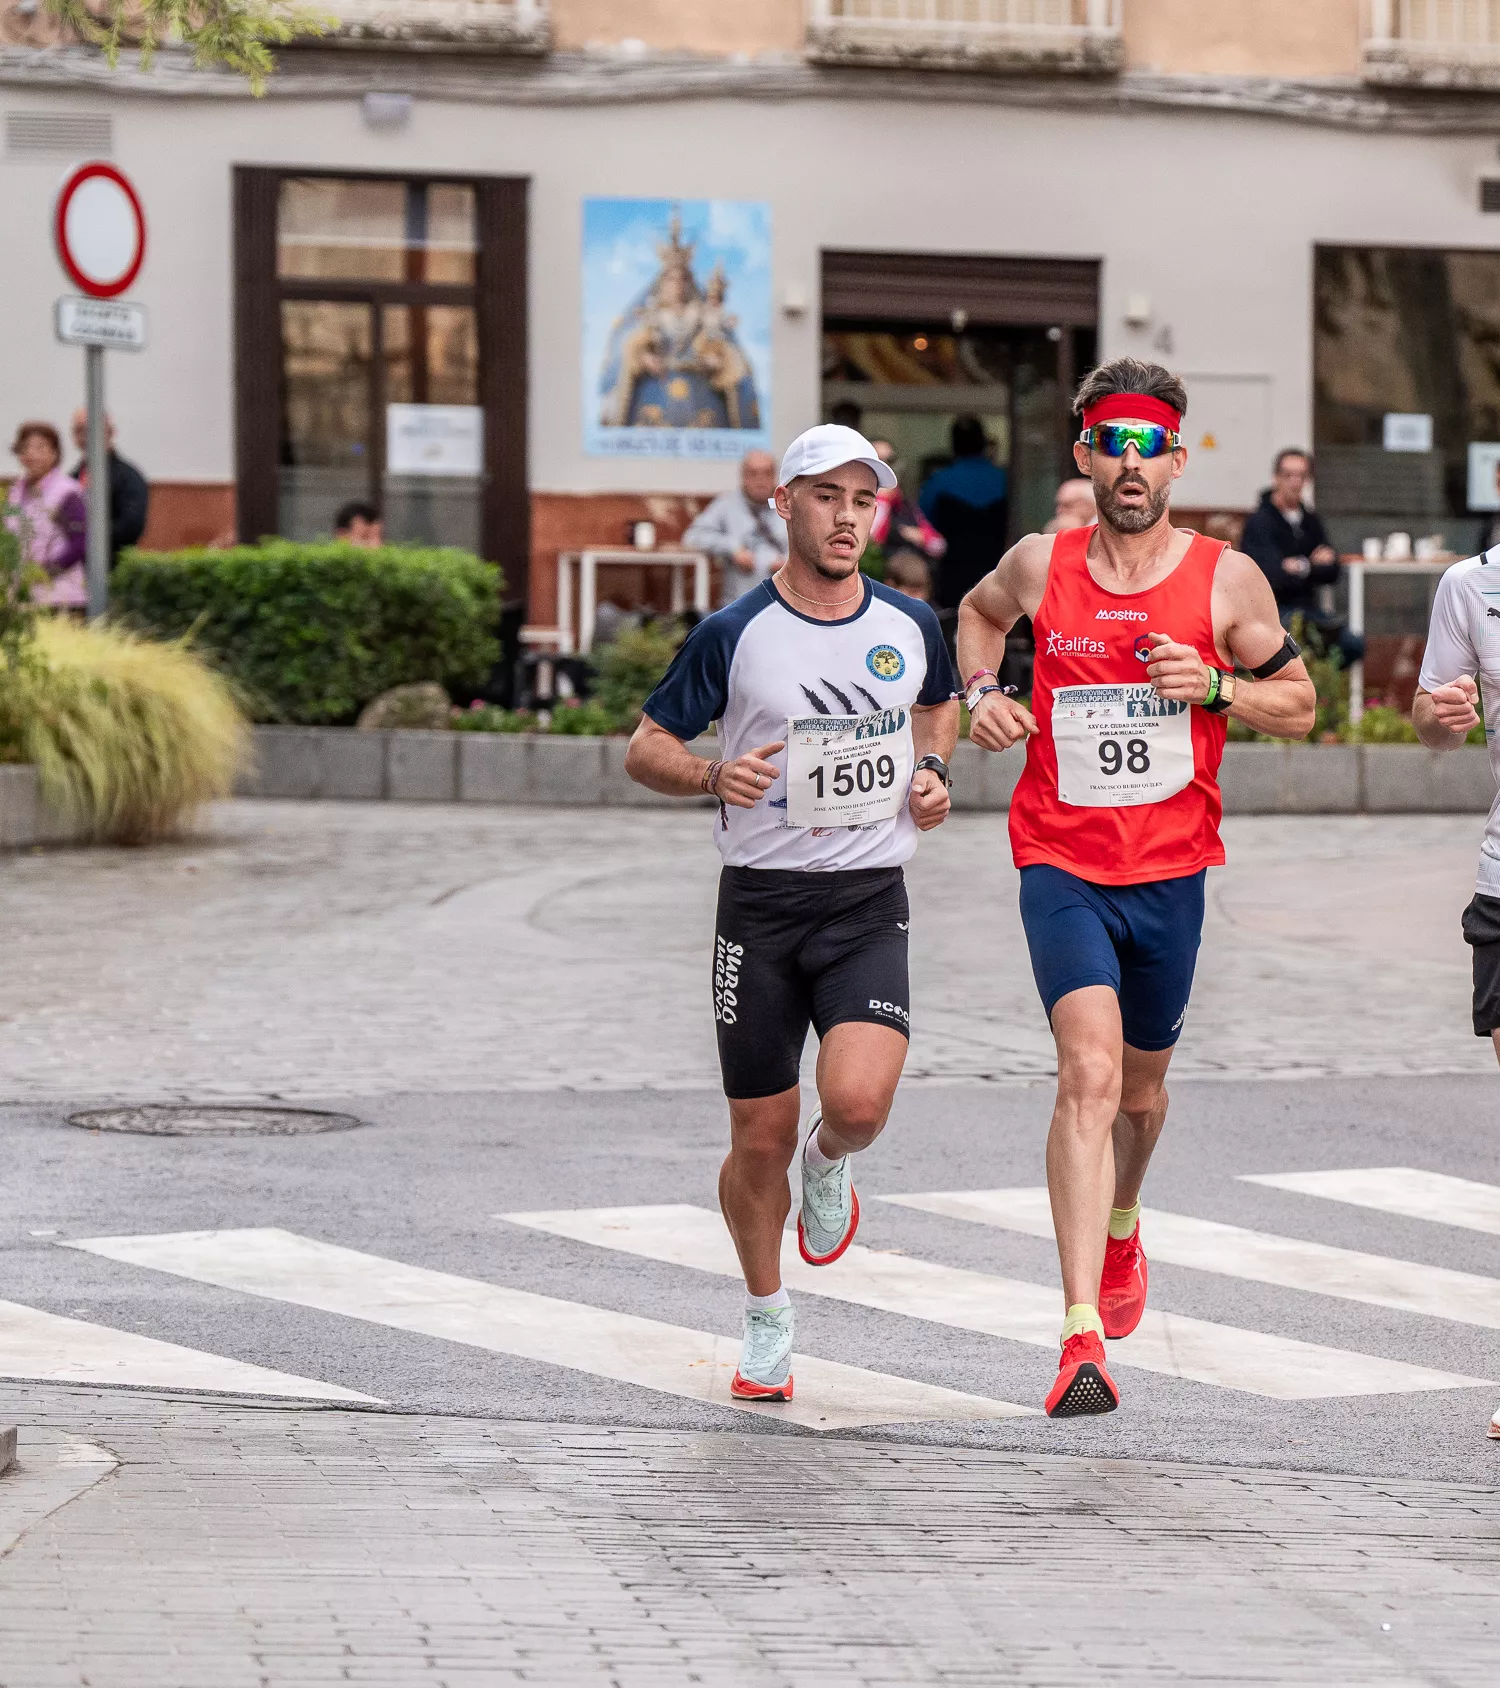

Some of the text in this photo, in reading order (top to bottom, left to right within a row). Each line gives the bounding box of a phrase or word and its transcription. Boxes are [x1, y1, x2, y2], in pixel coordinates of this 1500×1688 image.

[1057, 636, 1106, 653] califas
[864, 741, 881, 749] LUCENA
[850, 750, 872, 758] IGUALDAD
[1098, 739, 1150, 775] 98
[808, 754, 895, 798] 1509
[828, 804, 852, 812] ANTONIO
[853, 800, 876, 808] HURTADO
